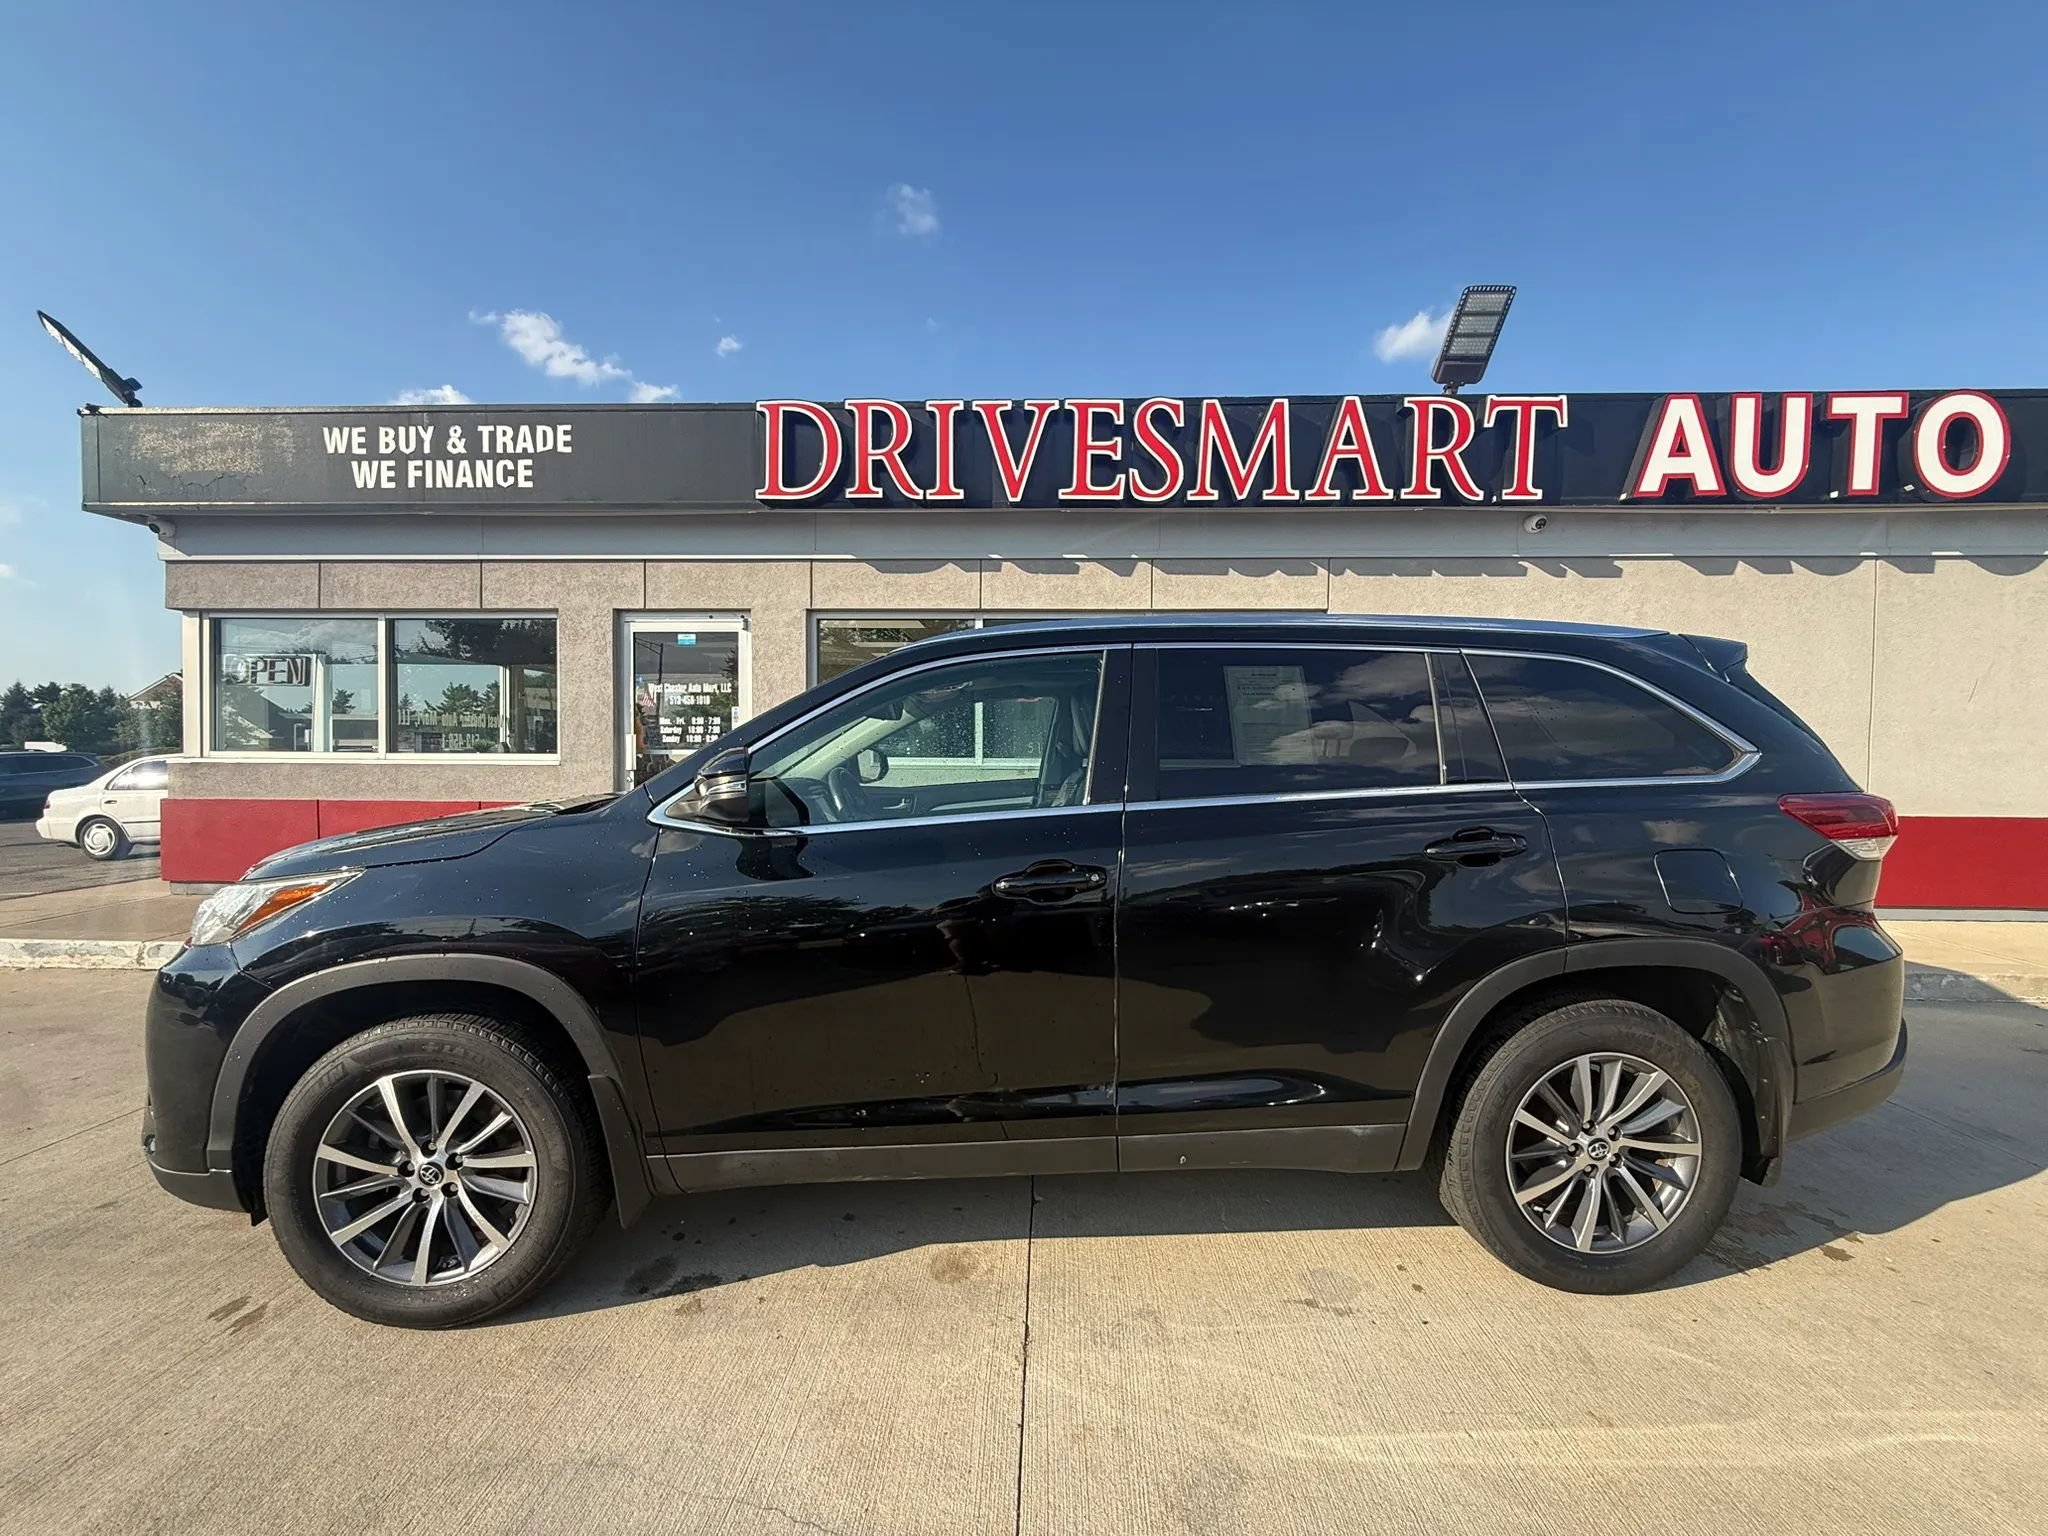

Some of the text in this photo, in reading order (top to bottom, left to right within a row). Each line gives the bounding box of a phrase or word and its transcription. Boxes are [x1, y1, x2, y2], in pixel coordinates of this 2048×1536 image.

[323, 424, 573, 455] WE BUY & TRADE
[755, 389, 2013, 503] DRIVESMART AUTO
[351, 459, 534, 489] WE FINANCE
[226, 655, 310, 687] OPEN
[664, 682, 688, 694] Chester
[687, 682, 702, 693] Auto
[702, 682, 720, 695] Mart,
[721, 682, 732, 693] LLC
[660, 725, 682, 735] Saturday
[662, 734, 681, 744] Sunday
